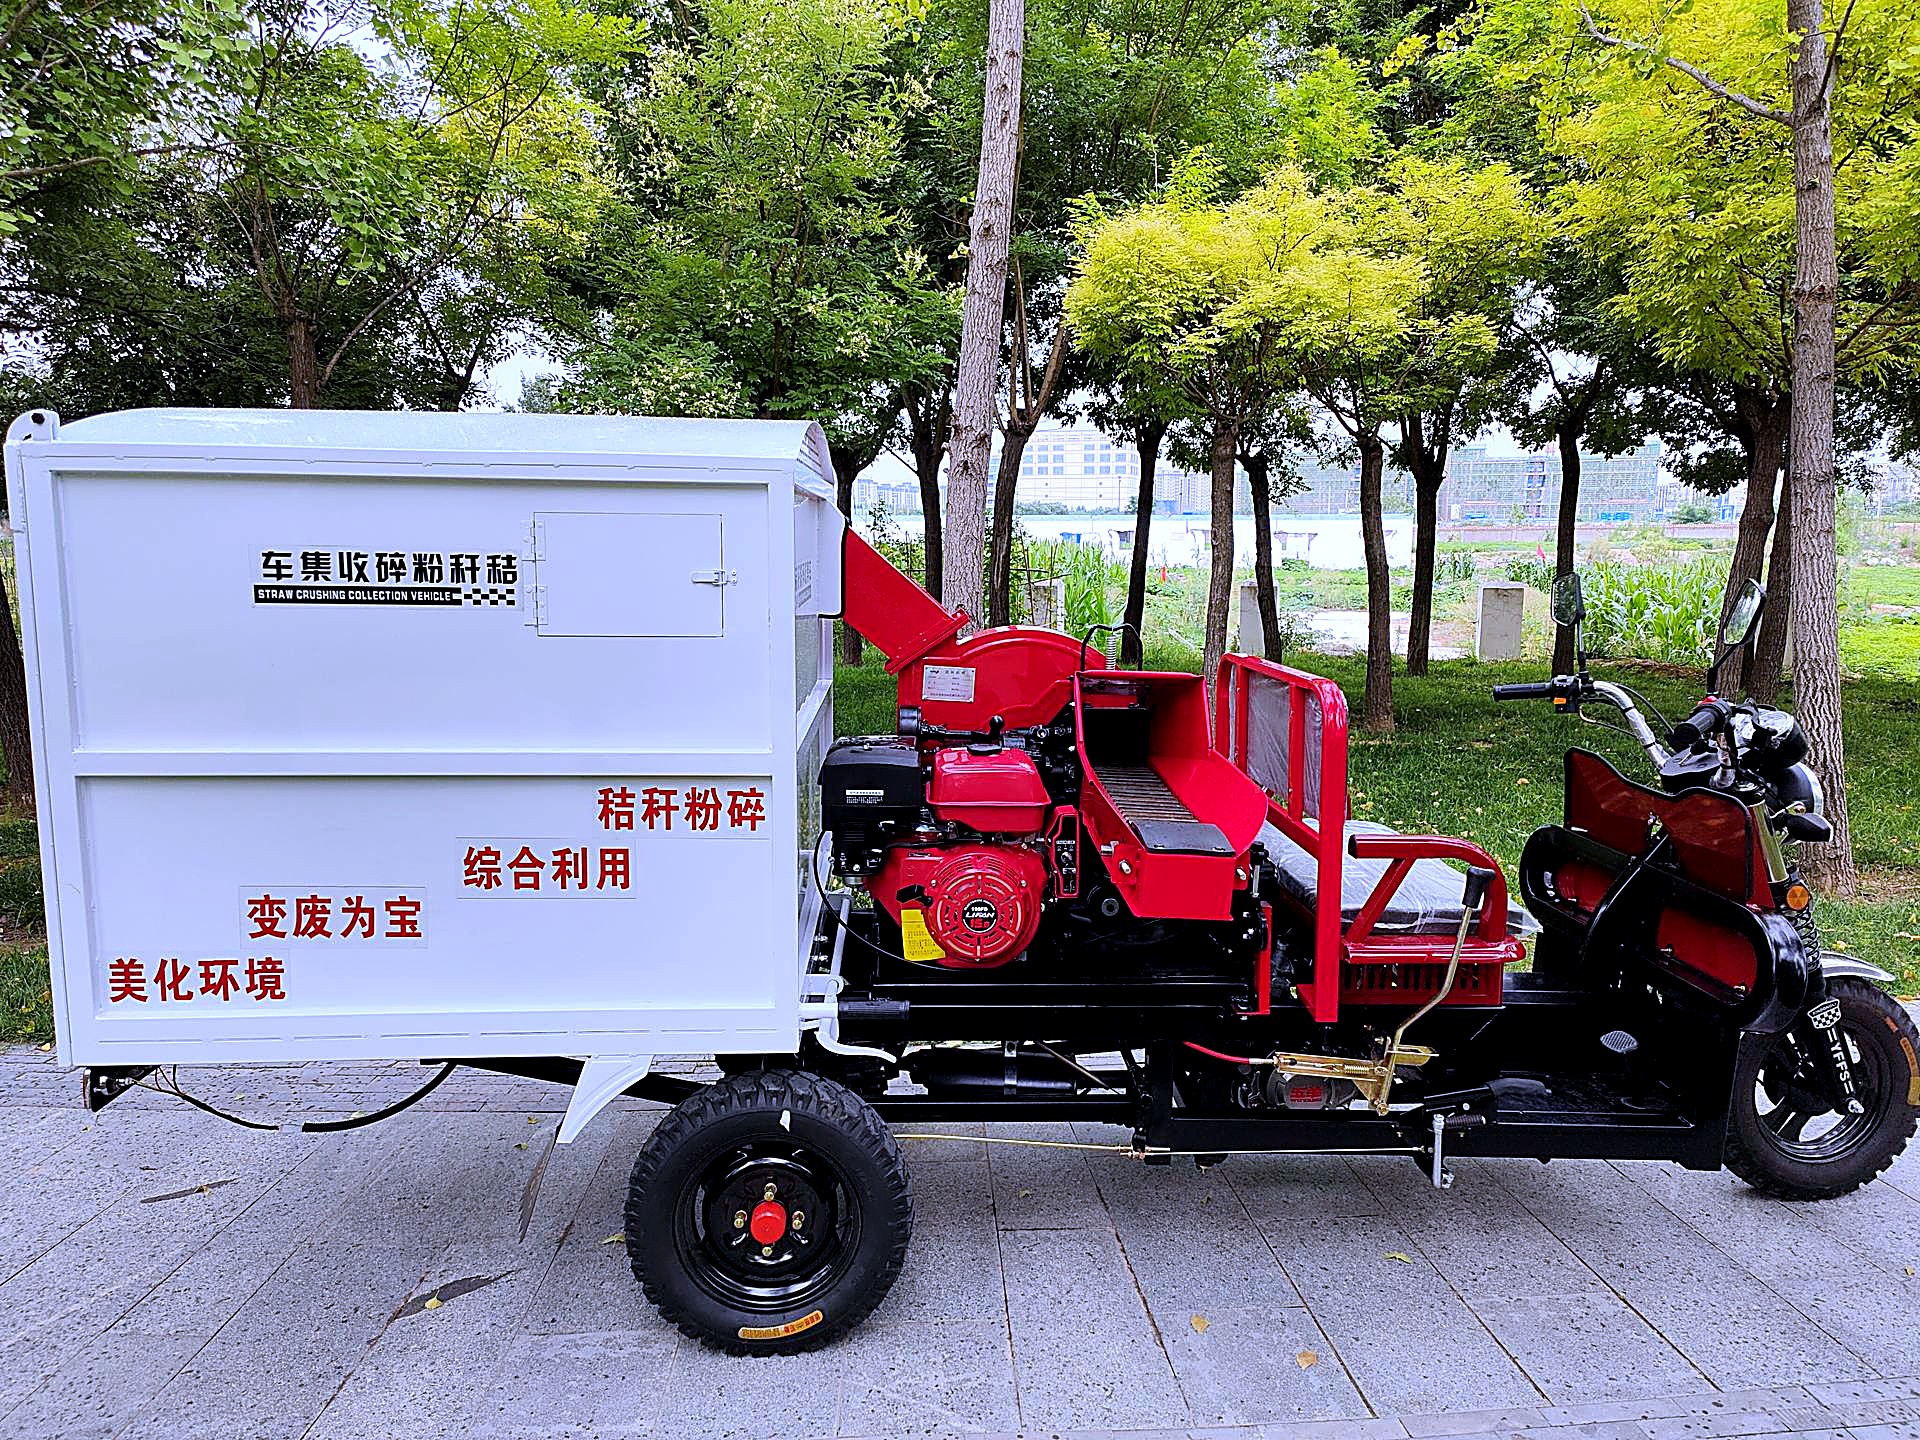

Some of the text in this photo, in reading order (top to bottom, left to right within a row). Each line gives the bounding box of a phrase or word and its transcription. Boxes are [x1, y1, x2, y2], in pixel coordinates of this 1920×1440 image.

[257, 589, 451, 601] STRAW CRUSHING COLLECTION VEHICLE
[598, 786, 766, 832] 秸秆粉碎
[463, 847, 631, 891] 综合利用
[247, 895, 423, 939] 变废为宝
[109, 957, 286, 1003] 美化环境
